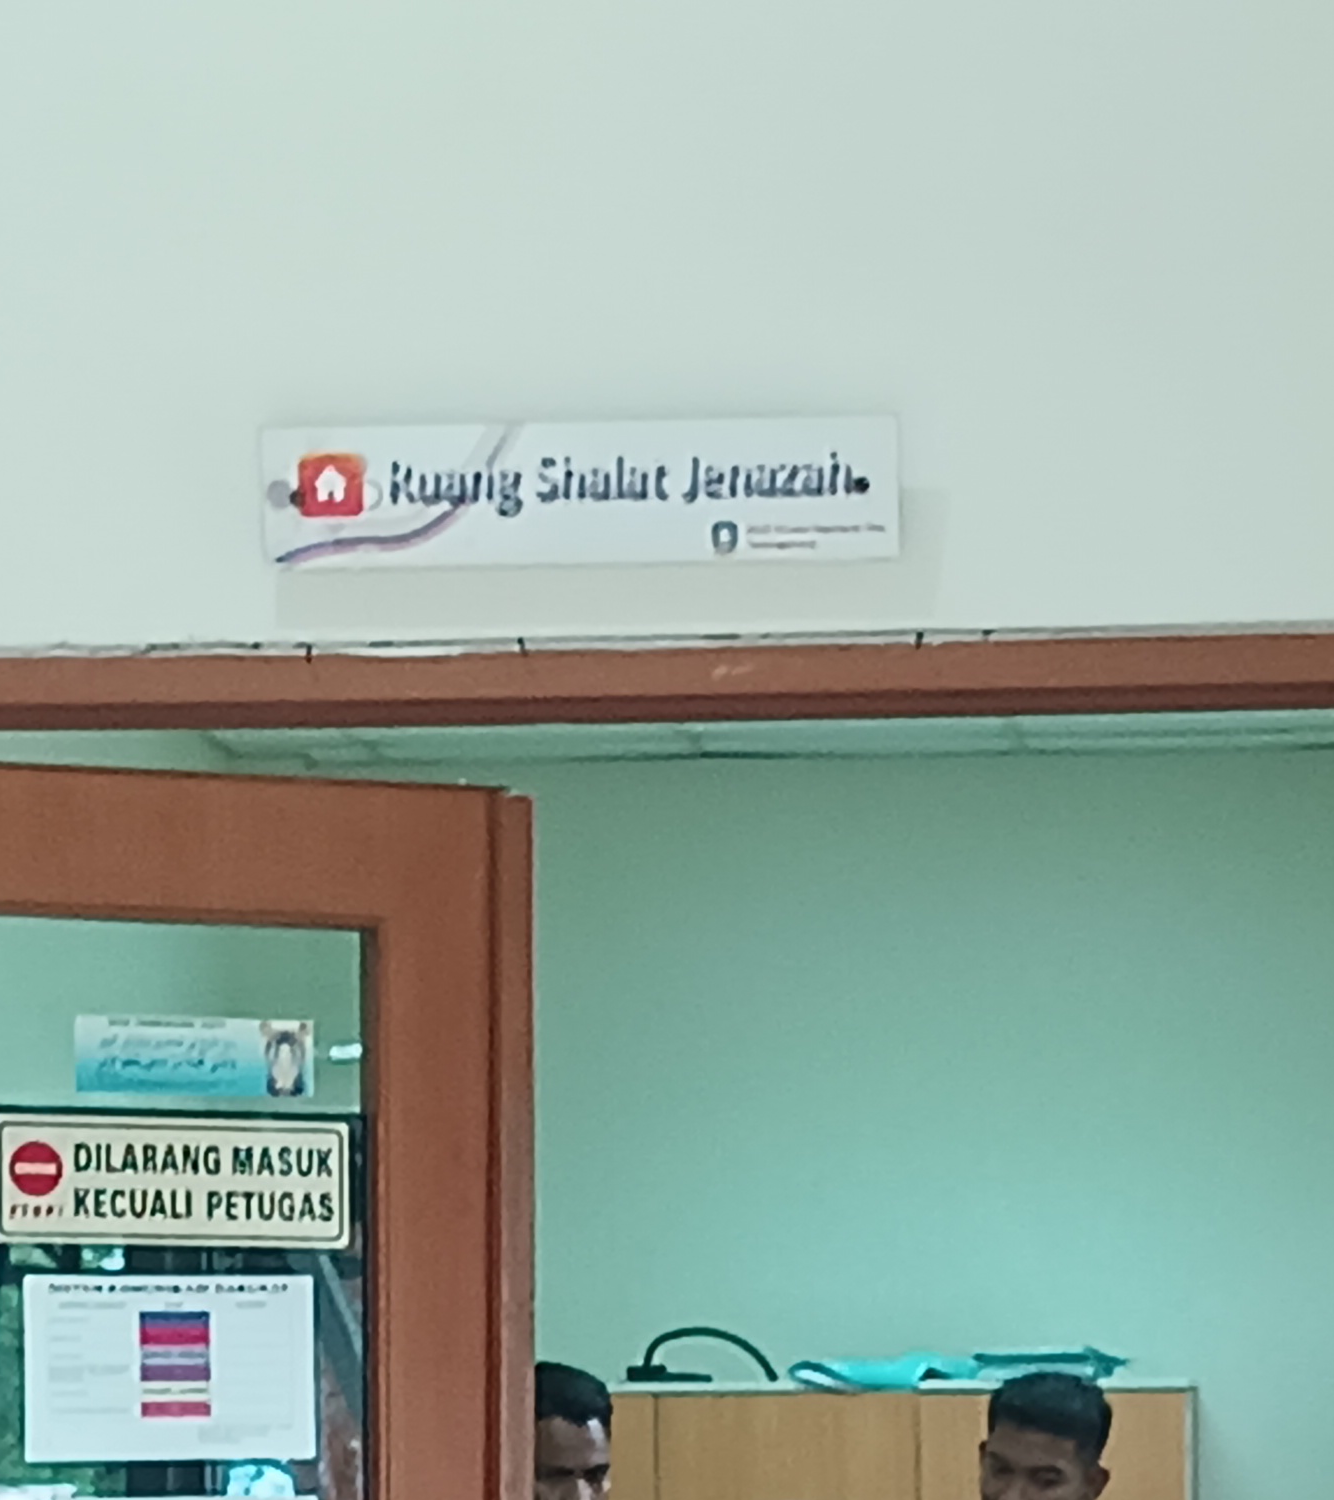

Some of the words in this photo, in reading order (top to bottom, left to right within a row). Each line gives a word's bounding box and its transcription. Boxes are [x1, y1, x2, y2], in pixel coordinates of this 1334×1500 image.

[390, 460, 524, 518] Ruang
[536, 456, 669, 504] Shalat
[73, 1142, 221, 1176] DILARANG
[232, 1146, 333, 1178] MASUK
[73, 1188, 192, 1219] KECUALI
[207, 1191, 334, 1222] PETUGAS
